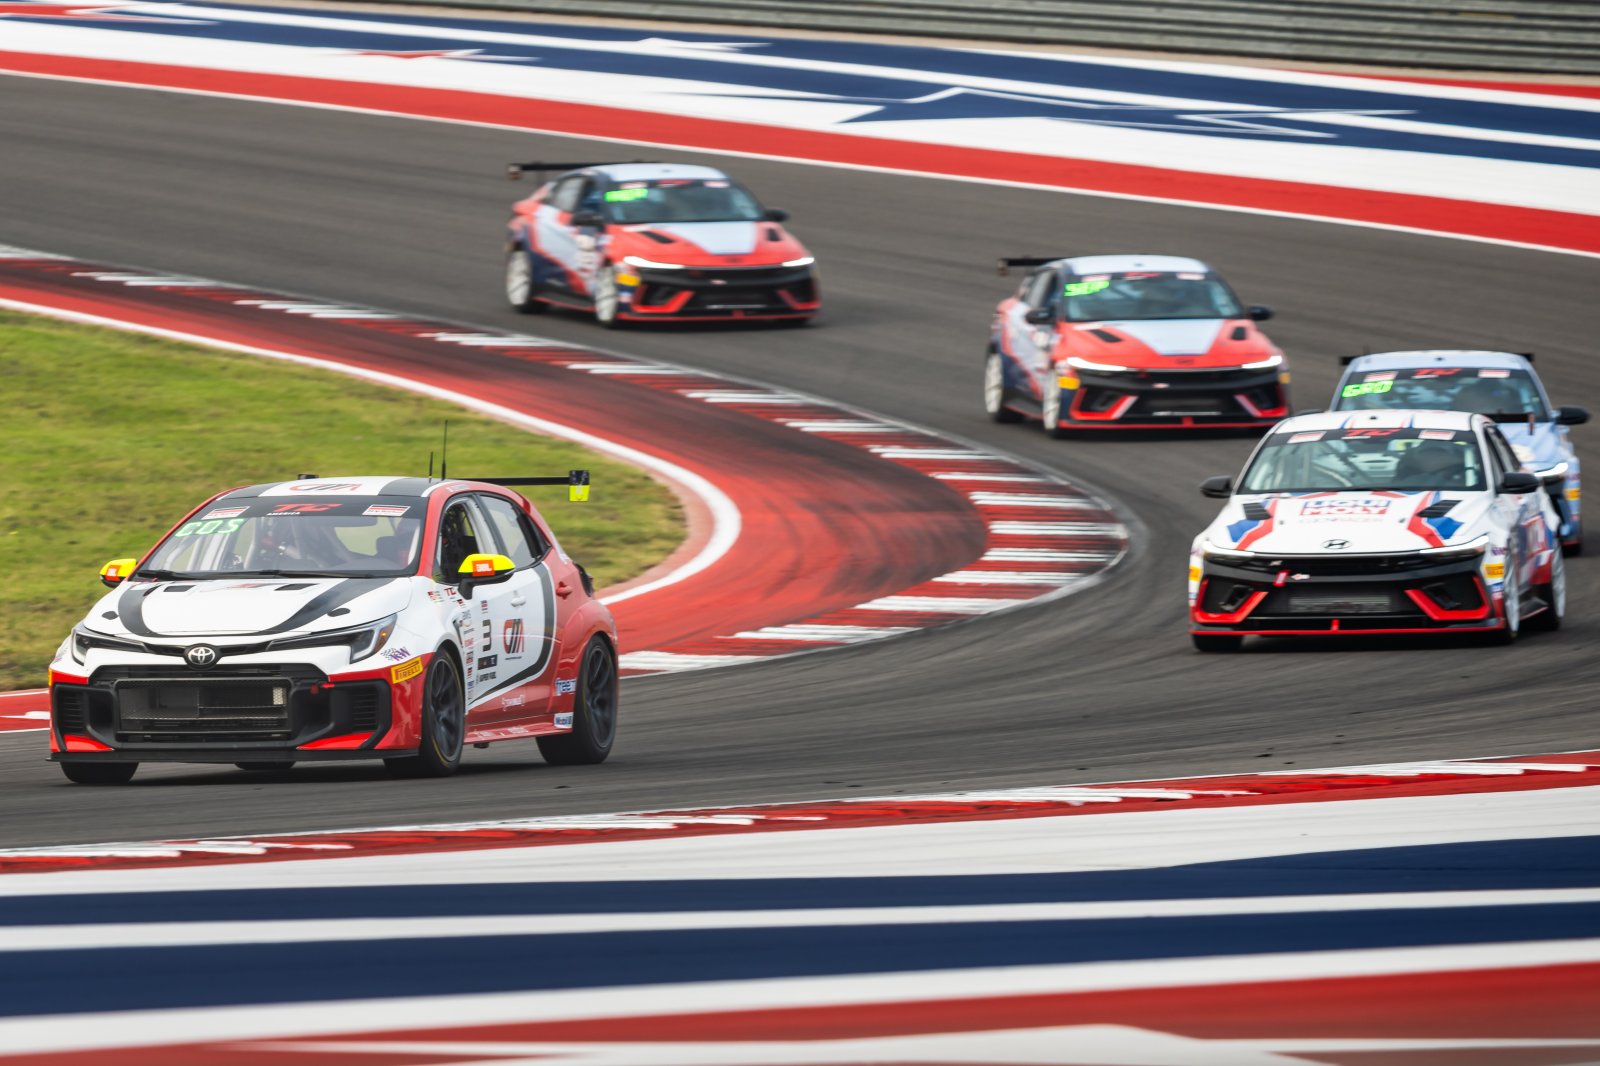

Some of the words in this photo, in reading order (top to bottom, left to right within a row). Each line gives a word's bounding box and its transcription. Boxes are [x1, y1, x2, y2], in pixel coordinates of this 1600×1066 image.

[1300, 507, 1387, 516] MOLY
[482, 619, 492, 652] 3
[394, 659, 421, 682] PIRELLI
